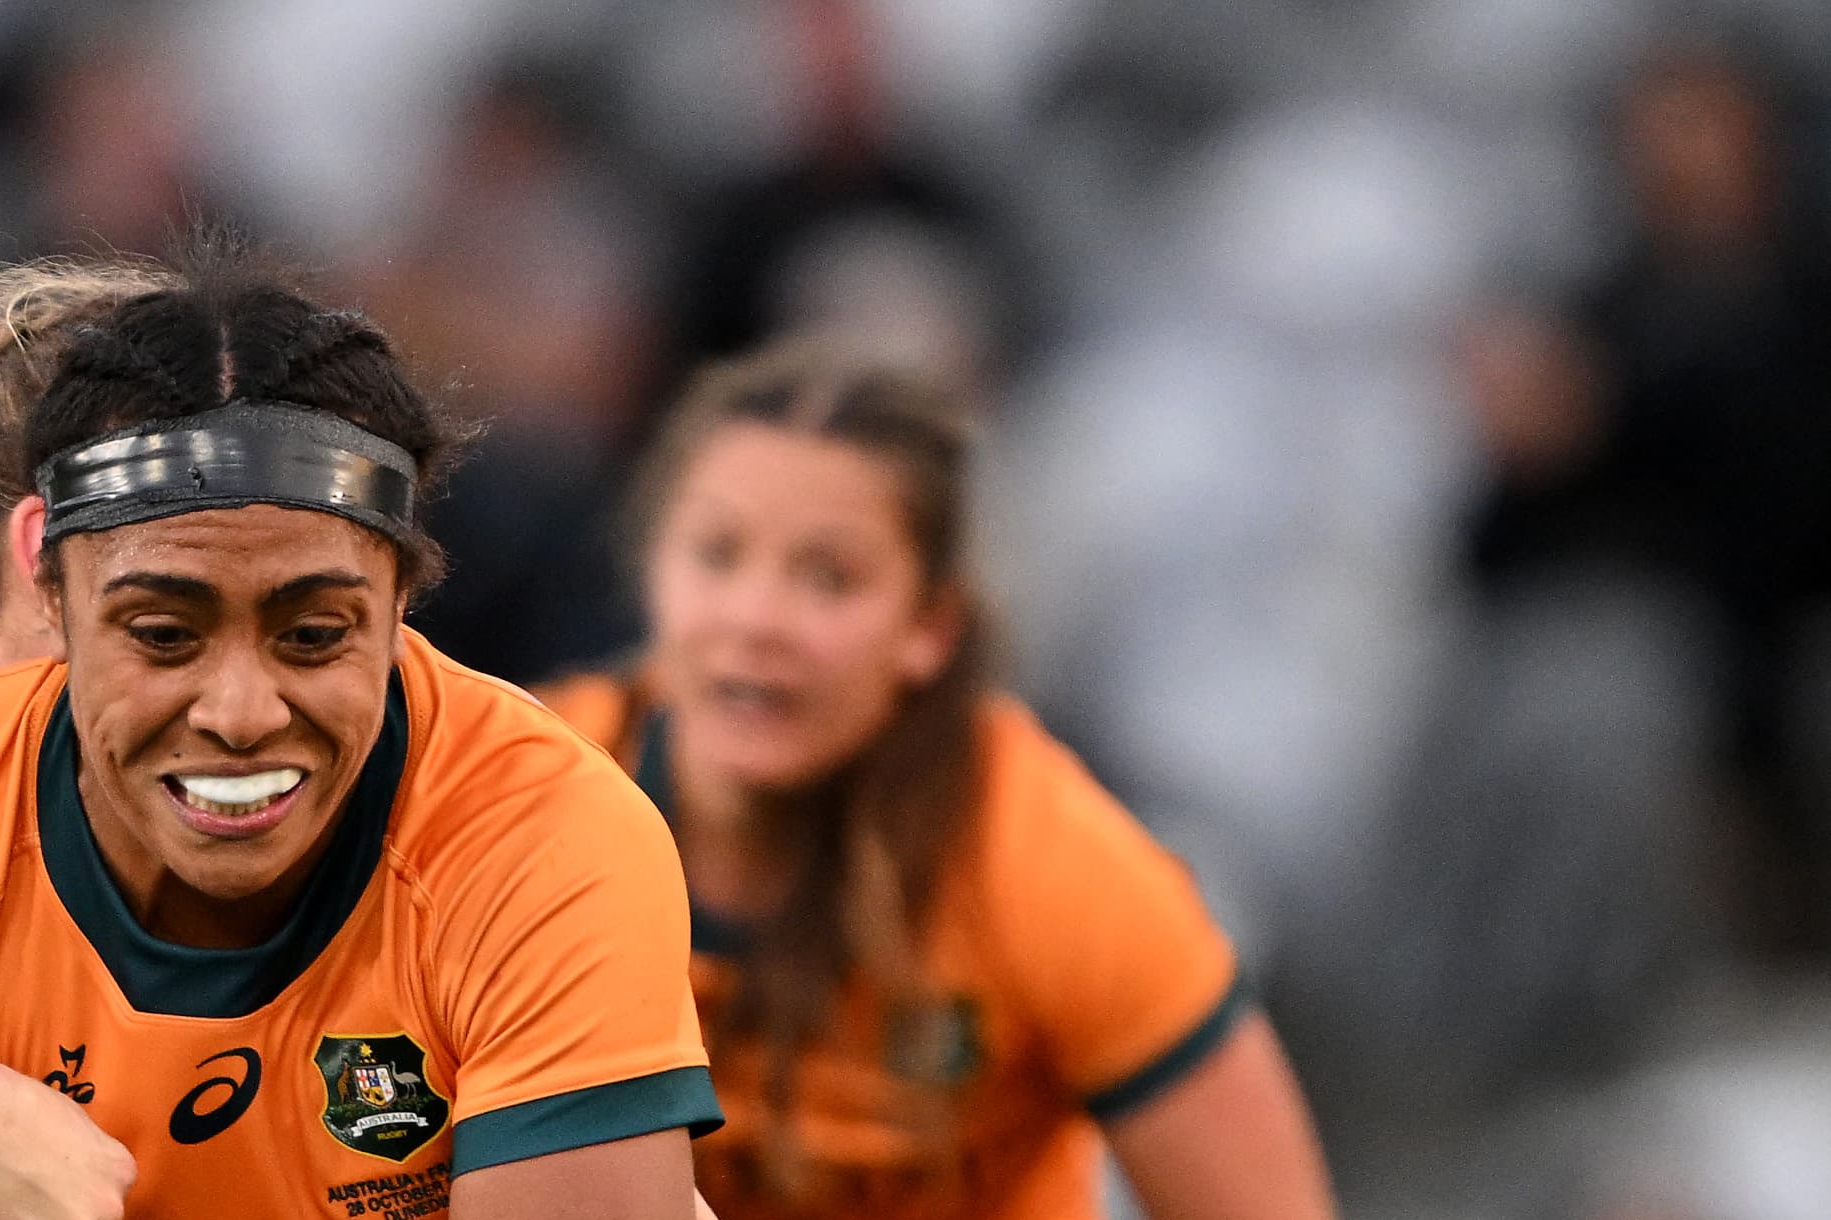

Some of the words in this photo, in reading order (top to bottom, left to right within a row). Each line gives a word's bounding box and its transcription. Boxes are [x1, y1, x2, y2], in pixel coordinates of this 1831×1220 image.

[359, 1112, 418, 1128] AUSTRALIA
[328, 1173, 414, 1203] AUSTRALIA
[368, 1181, 446, 1212] OCTOBER
